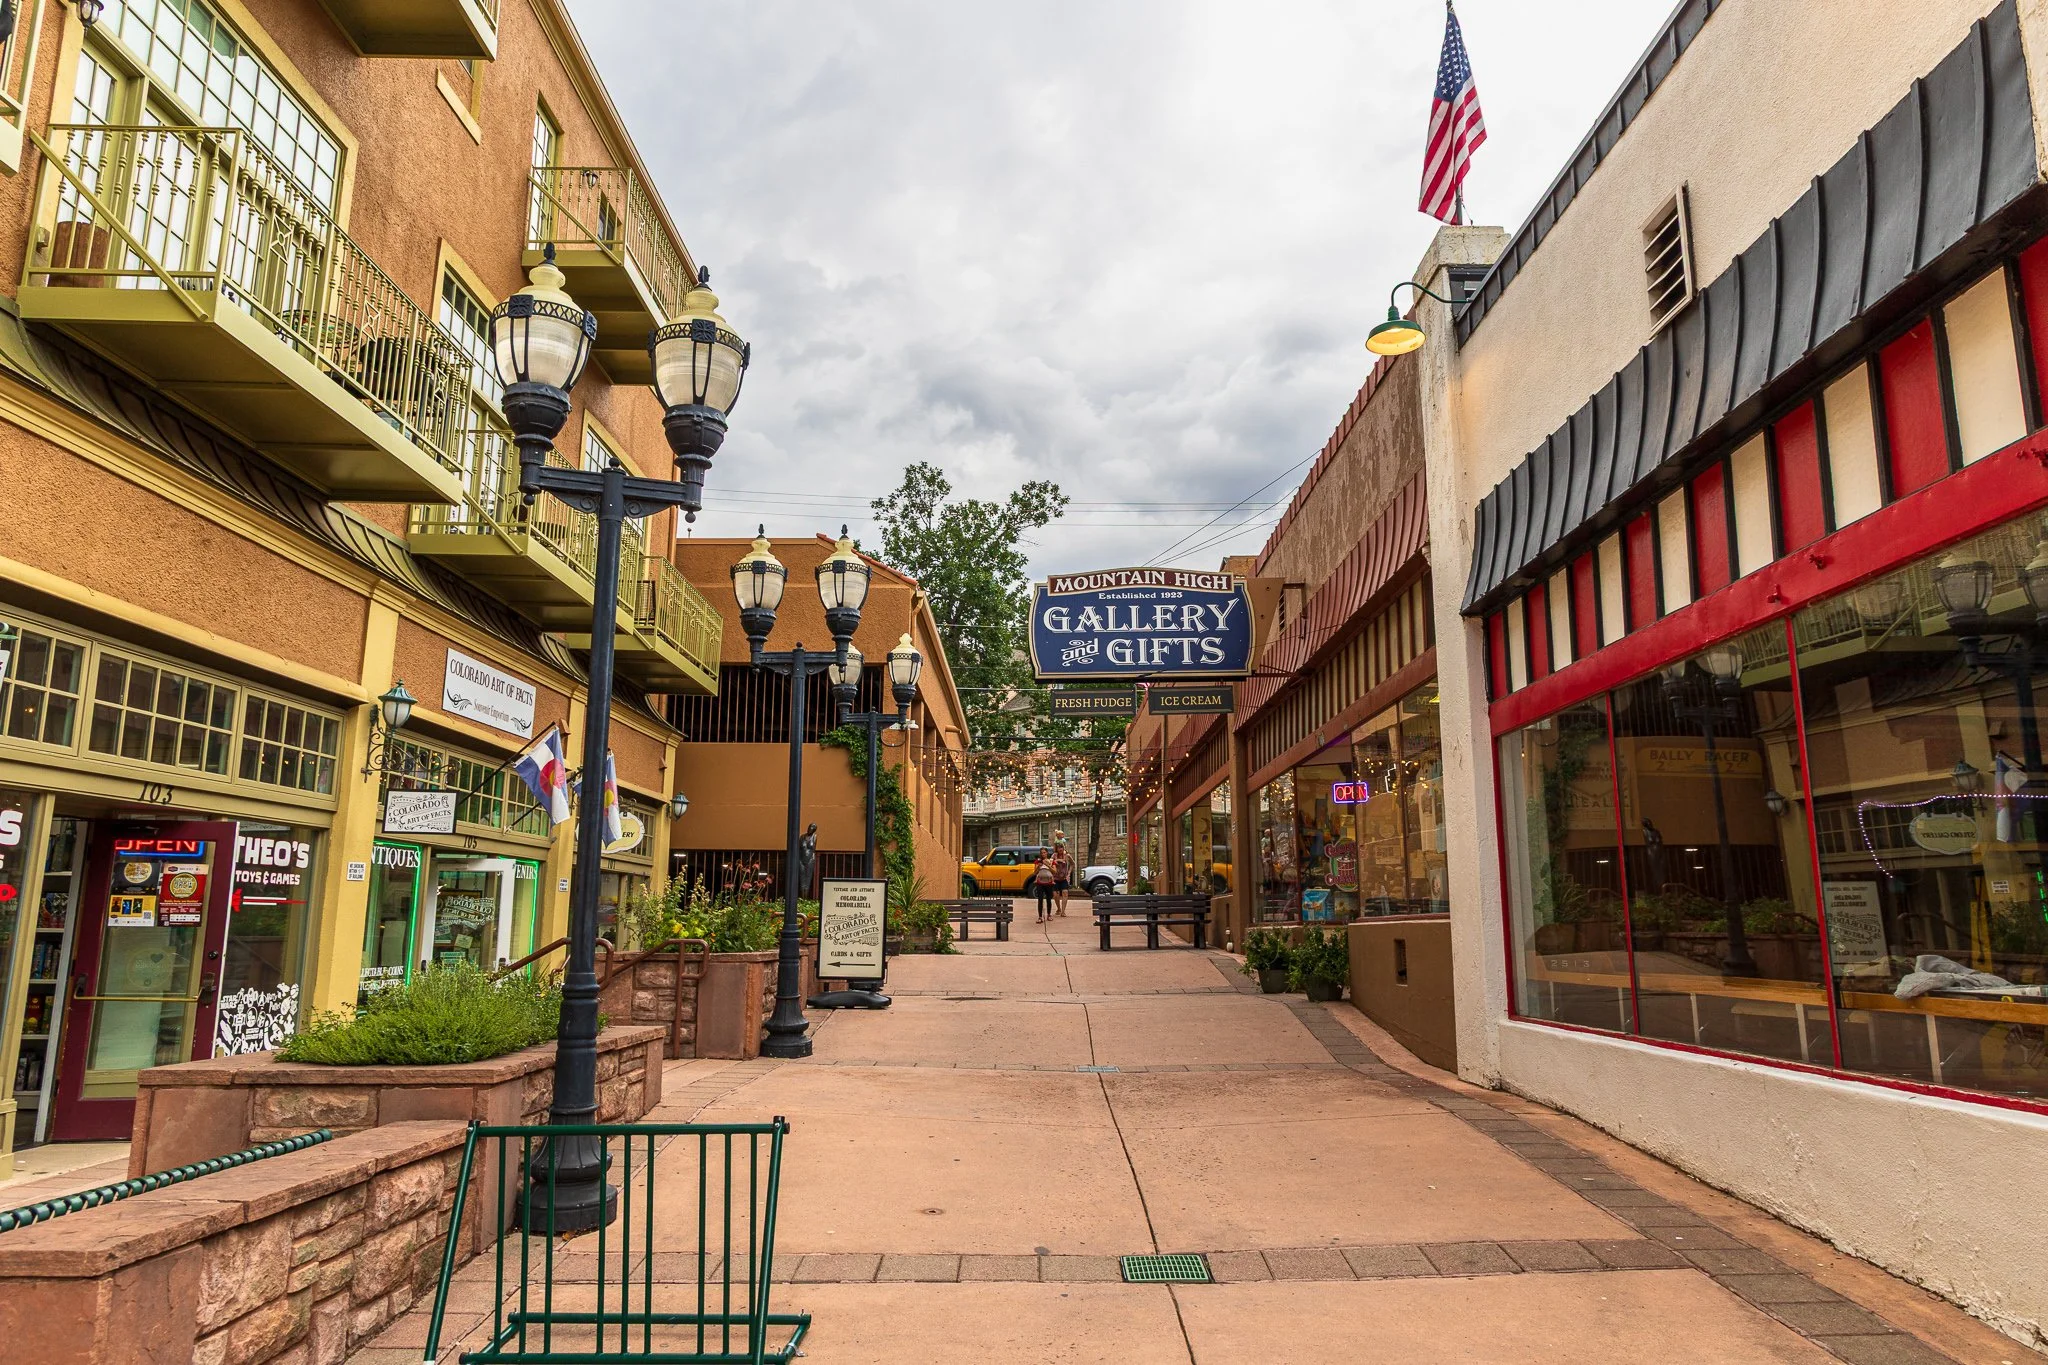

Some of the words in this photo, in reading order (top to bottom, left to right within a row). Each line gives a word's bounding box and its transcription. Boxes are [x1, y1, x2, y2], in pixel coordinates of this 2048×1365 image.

[1054, 570, 1165, 593] MOUNTAIN
[1174, 572, 1228, 590] HIGH
[1098, 591, 1156, 600] Established
[1160, 591, 1183, 599] 1923
[1043, 597, 1240, 634] GALLERY
[1061, 637, 1099, 662] and
[1106, 636, 1225, 666] GIFTS
[450, 658, 490, 688] COLORADO
[491, 676, 505, 694] ART
[505, 683, 514, 698] OF
[515, 687, 533, 706] FACTS
[1055, 698, 1091, 708] FRESH
[1093, 697, 1132, 708] FUDGE
[1160, 696, 1179, 706] ICE
[1181, 695, 1222, 706] CREAM
[1649, 749, 1695, 761] BALLY
[138, 783, 173, 805] 103
[393, 799, 441, 817] COLORADO
[407, 817, 420, 825] ART
[463, 835, 478, 849] 105
[235, 835, 310, 869] THEO'S
[371, 845, 421, 870] NTIQUES
[235, 870, 262, 884] TOYS
[262, 871, 270, 886] &
[269, 872, 301, 886] GAMES
[515, 863, 537, 880] ENIRS
[828, 917, 870, 934] COLORADO
[841, 933, 853, 941] ART
[860, 926, 880, 935] FACTS
